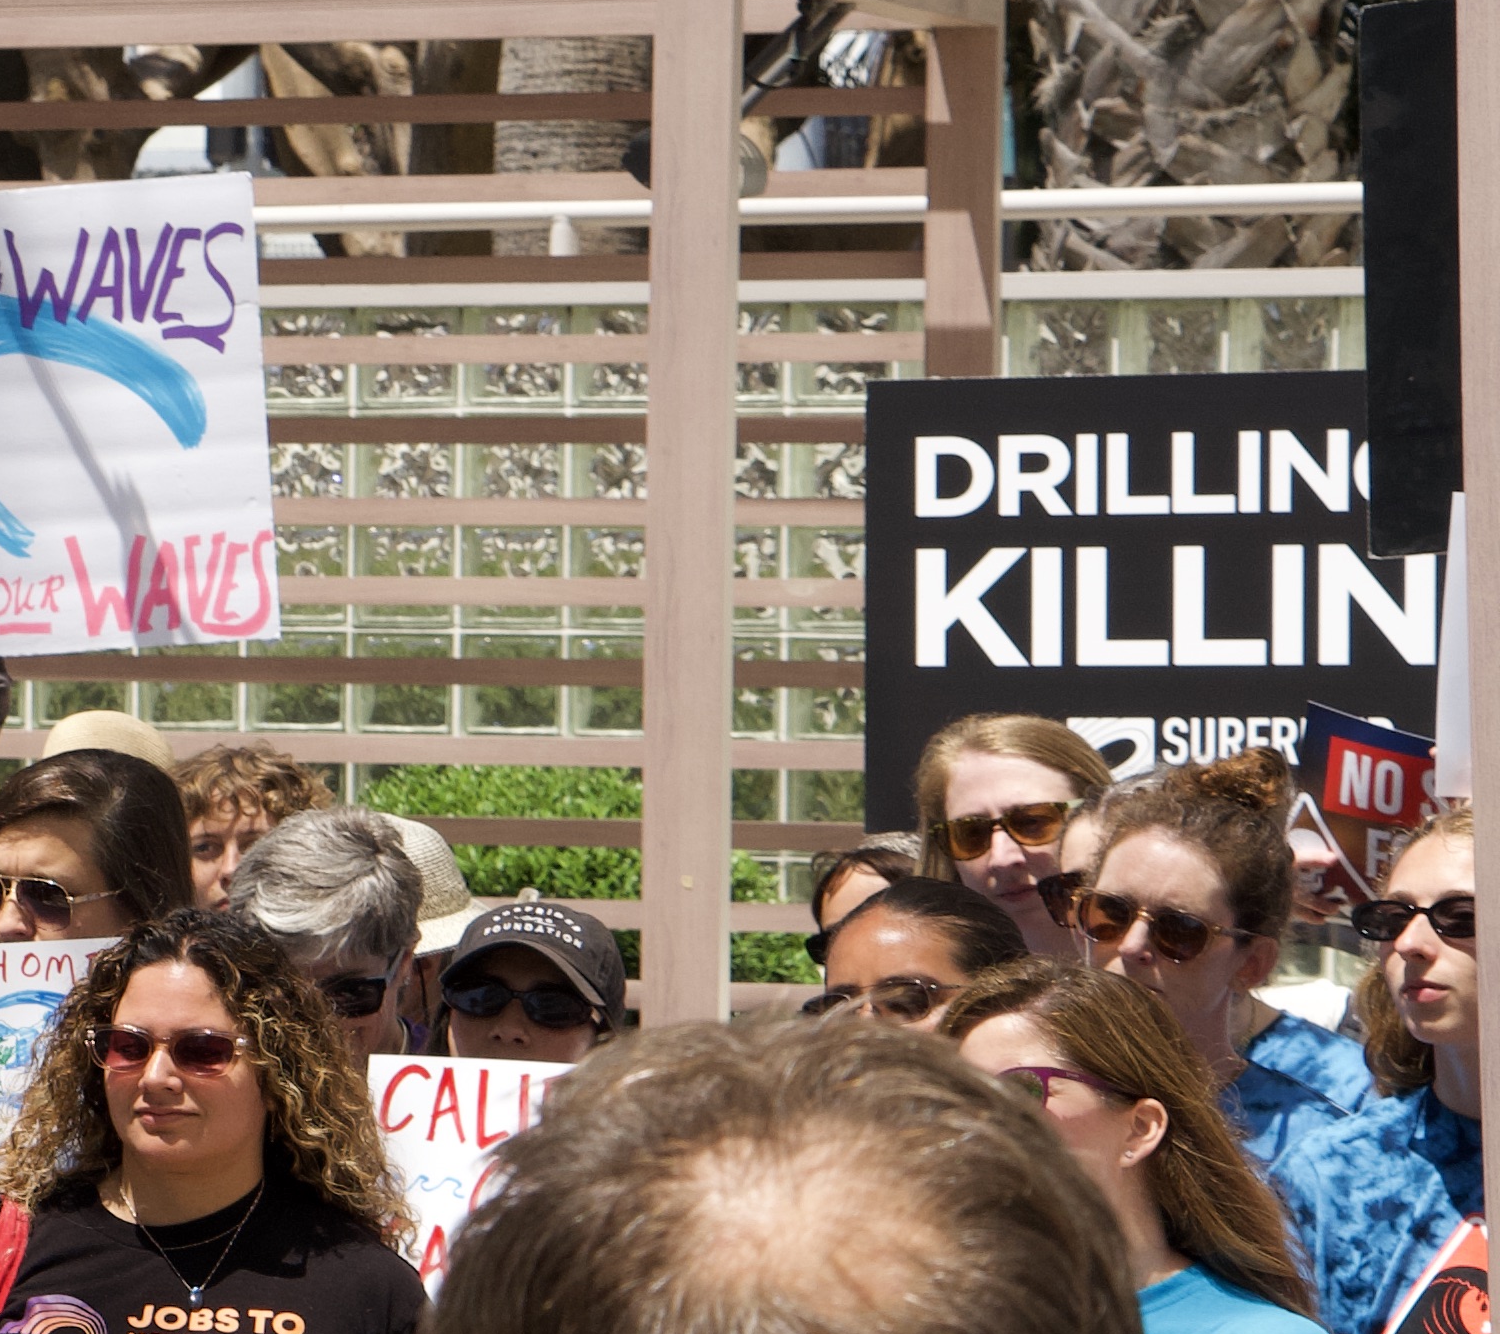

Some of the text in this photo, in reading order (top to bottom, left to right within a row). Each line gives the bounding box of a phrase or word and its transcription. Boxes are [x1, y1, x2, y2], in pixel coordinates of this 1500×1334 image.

[4, 222, 244, 354] WAVES
[916, 429, 1369, 517] DRILLIN
[64, 529, 275, 637] WAVES
[915, 544, 1436, 668] KILLIN
[1339, 749, 1404, 814] NO
[483, 922, 583, 949] FOUNDATION
[127, 1304, 240, 1334] JOBS
